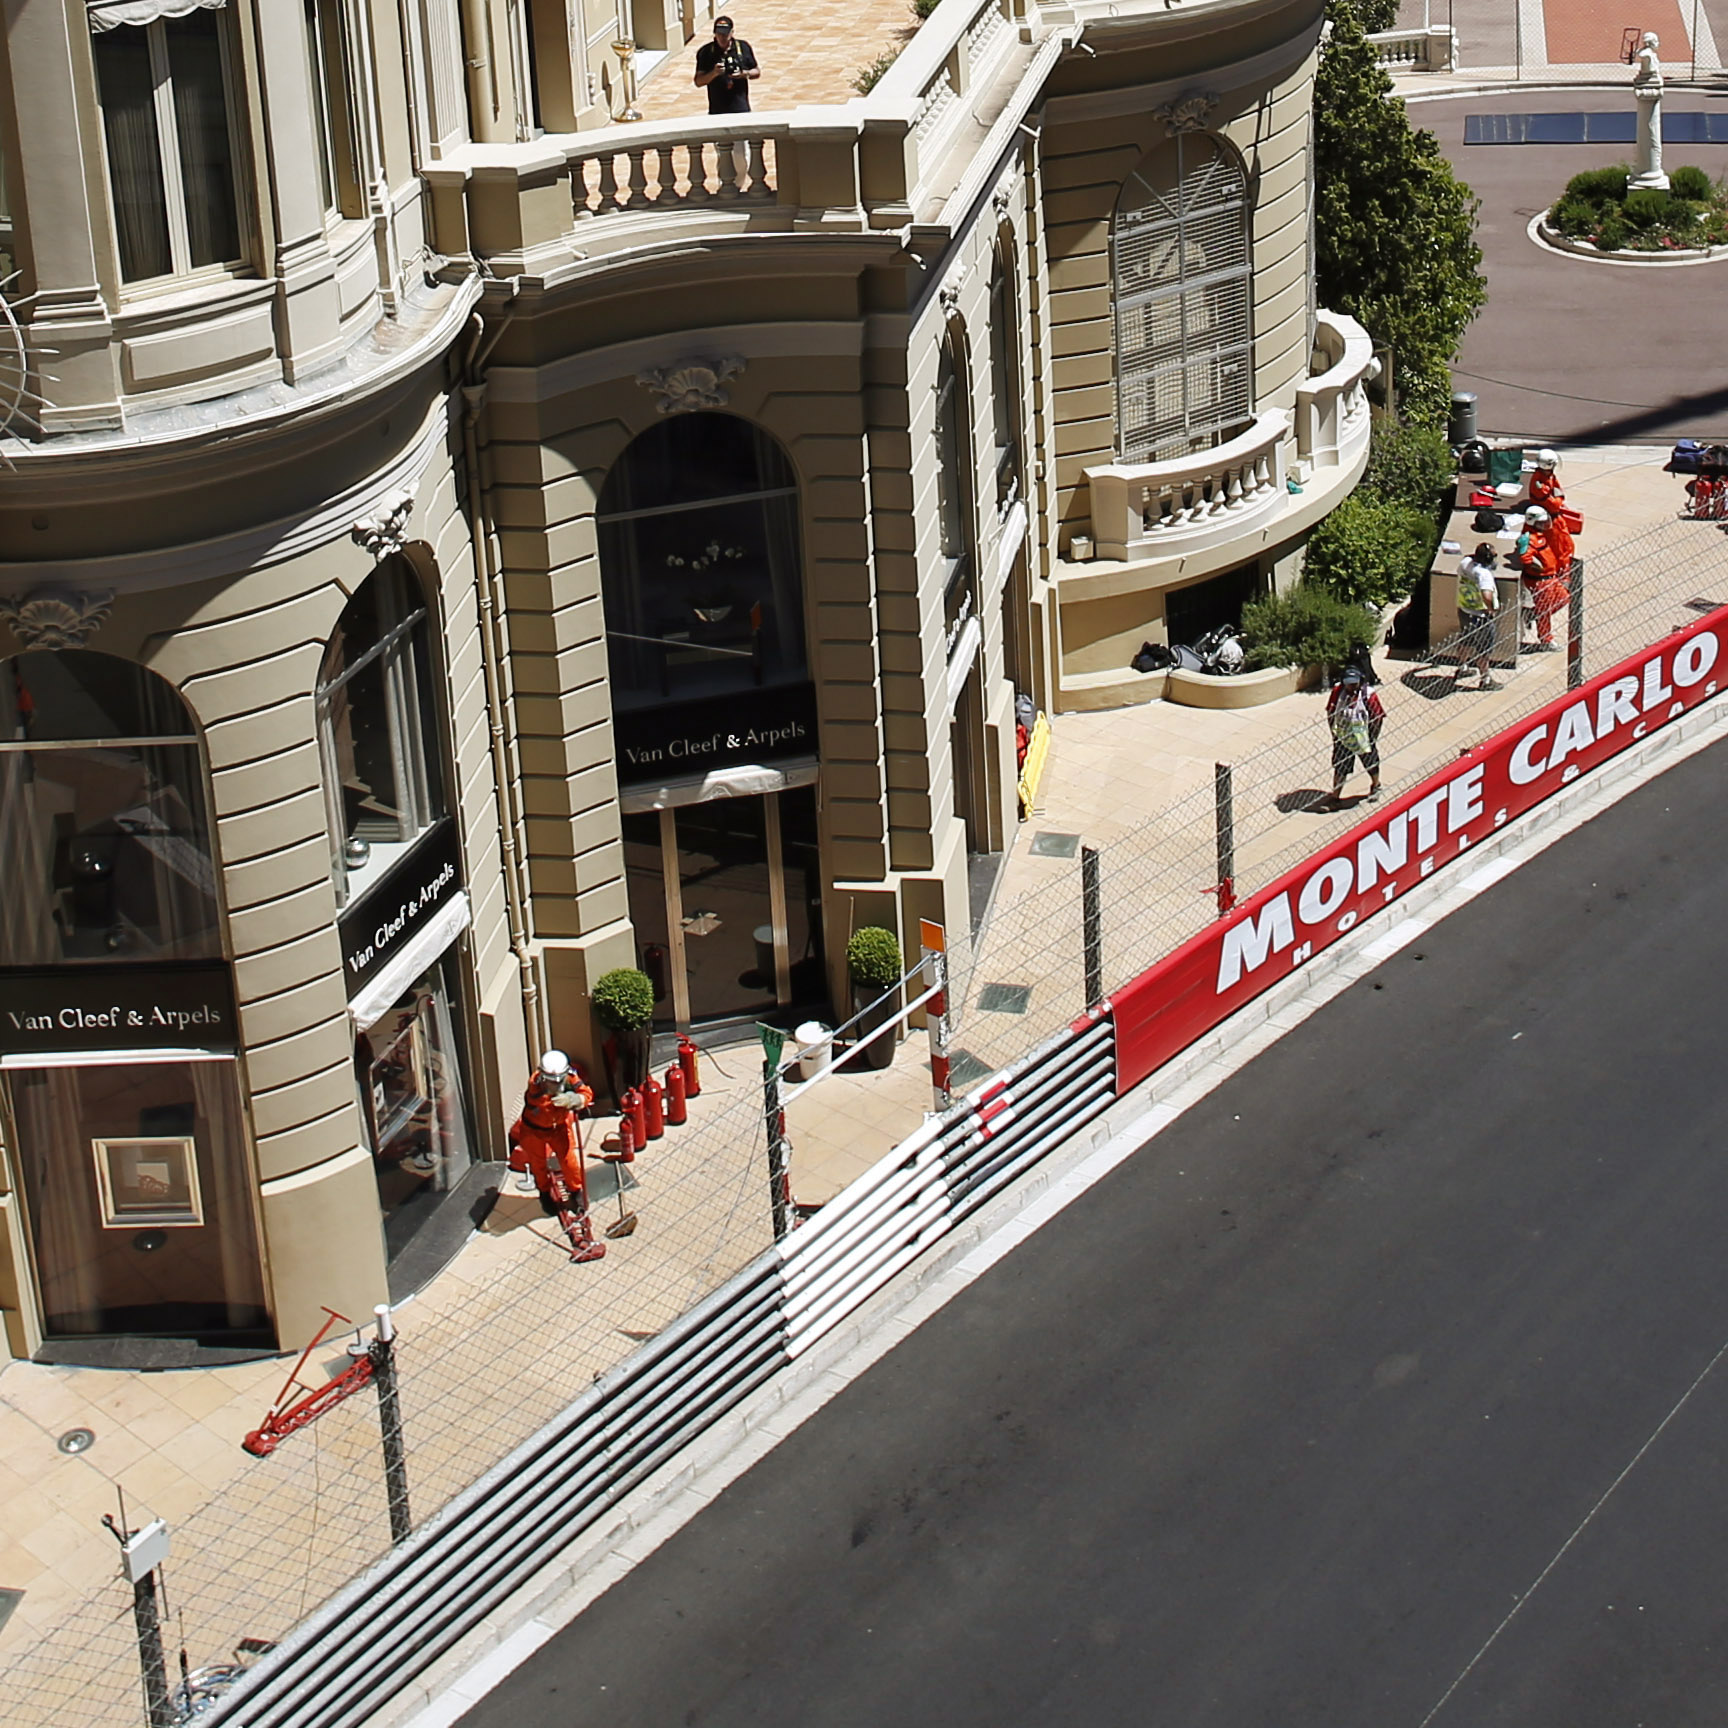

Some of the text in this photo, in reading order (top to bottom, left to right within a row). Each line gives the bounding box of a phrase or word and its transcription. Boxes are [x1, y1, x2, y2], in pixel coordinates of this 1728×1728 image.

[625, 721, 806, 765] Van Cleef & Arpels
[1216, 761, 1486, 996] MONTE
[1508, 631, 1720, 786] CARLO
[1292, 807, 1508, 966] HOTELS
[1560, 763, 1581, 783] &
[348, 862, 455, 973] Van Cleef & Arpels
[8, 1004, 221, 1031] Van Cleef & Arpels
